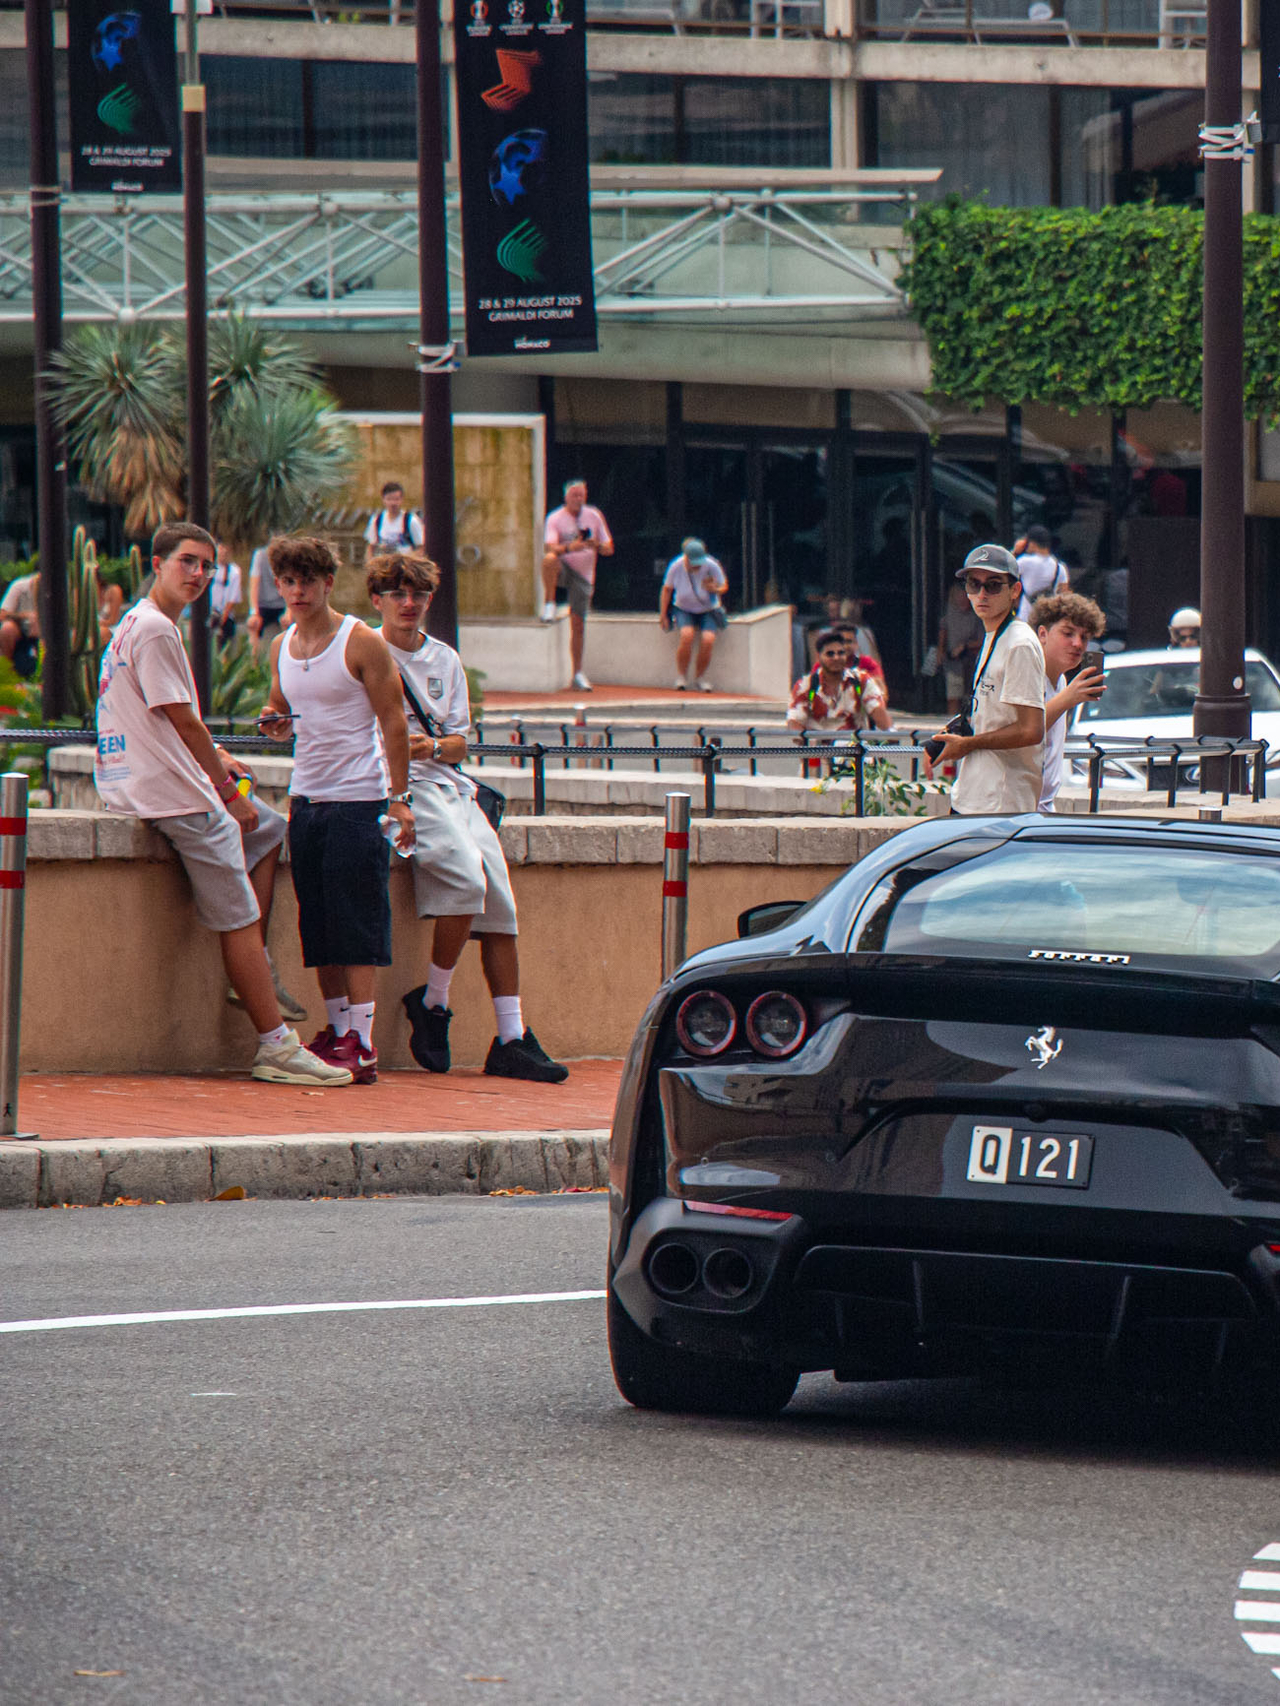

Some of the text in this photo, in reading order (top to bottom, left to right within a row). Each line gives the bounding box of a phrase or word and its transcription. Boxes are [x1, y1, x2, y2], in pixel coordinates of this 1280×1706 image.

[479, 299, 492, 309] 28
[516, 296, 555, 308] AUGUST
[557, 295, 582, 306] 2025
[488, 308, 574, 322] GRIMALDI FORUM
[1028, 949, 1130, 965] Ferrari
[980, 1134, 1079, 1180] Q 121
